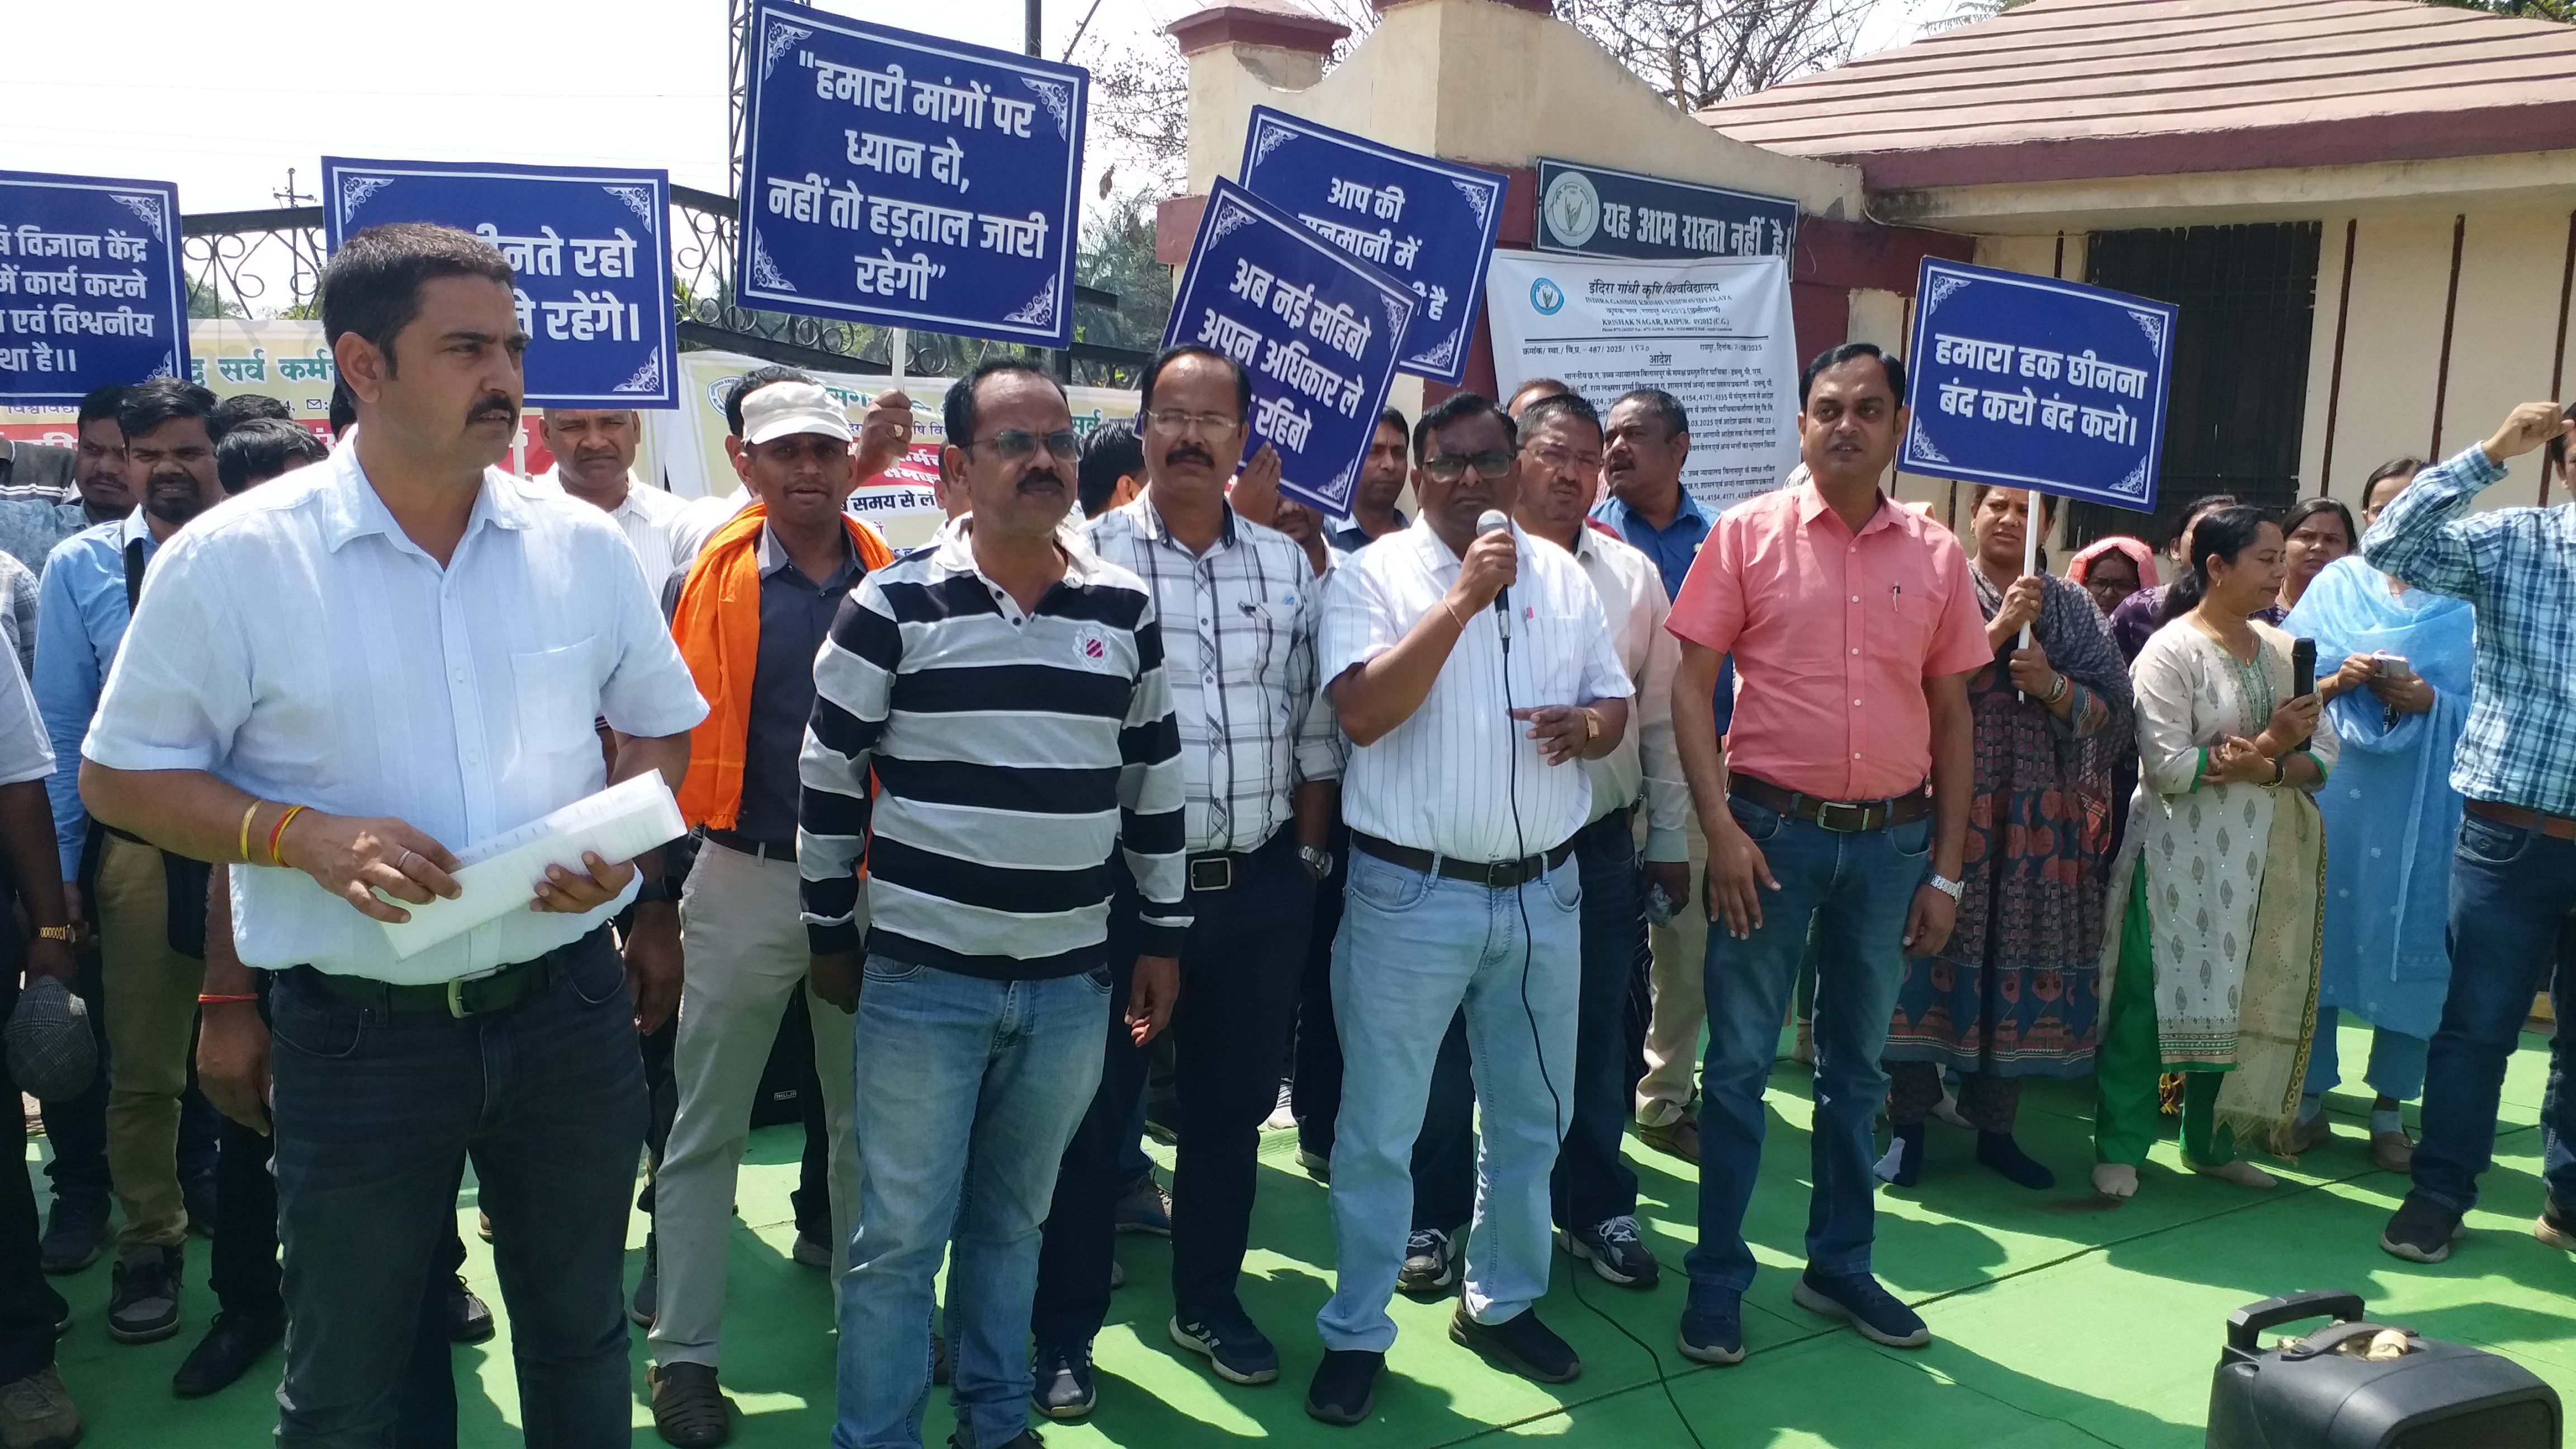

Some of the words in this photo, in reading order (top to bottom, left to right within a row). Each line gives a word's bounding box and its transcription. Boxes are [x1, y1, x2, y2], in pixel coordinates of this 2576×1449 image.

[911, 77, 991, 130] मांगों
[991, 96, 1036, 138] पर
[845, 129, 926, 179] ध्यान
[930, 136, 970, 194] दो,
[767, 173, 831, 224] नहीं
[829, 180, 864, 230] तो
[868, 196, 973, 247] हड़ताल
[977, 211, 1049, 259] जारी
[1327, 177, 1374, 214] आप
[1375, 185, 1406, 223] की
[15, 225, 101, 259] विज्ञान
[104, 228, 148, 263] केंद्र
[1602, 202, 1631, 239] यह
[1636, 206, 1678, 247] आम
[1681, 214, 1726, 254] रास्ता
[1730, 215, 1765, 256] नहीं
[569, 227, 637, 278] रहो
[1394, 237, 1423, 271] में
[21, 265, 78, 296] कार्य
[81, 268, 148, 299] करने
[1589, 279, 1615, 296] इंदिरा
[1617, 280, 1640, 295] गांधी
[1642, 281, 1663, 299] कृषि
[1663, 280, 1720, 295] विश्वविद्यालय
[1609, 297, 1637, 306] GANDHI
[1664, 295, 1732, 306] VISHWAVIDYALAYA
[9, 304, 47, 334] एवं
[541, 290, 640, 341] रहेंगे।
[1229, 257, 1275, 309] अब
[1272, 279, 1315, 330] नई
[1309, 303, 1372, 362] सहिबो
[1428, 284, 1448, 322] है
[1636, 318, 1663, 327] NAGAR,
[217, 348, 266, 381] सर्व
[1197, 307, 1263, 367] अपन
[1259, 339, 1343, 408] अधिकार
[1338, 373, 1365, 419] ले
[1564, 370, 1587, 380] माननीय
[1614, 370, 1640, 378] न्यायालय
[1649, 351, 1672, 364] आदेश
[1934, 333, 2015, 375] हमारा
[2018, 345, 2064, 381] हक
[2067, 349, 2148, 400] छीनना
[1601, 384, 1621, 392] लक्ष्मण
[1621, 381, 1635, 392] शर्मा
[1254, 397, 1313, 454] रहिबो
[1939, 377, 1978, 418] बंद
[1981, 386, 2038, 427] करो
[2040, 392, 2078, 434] बंद
[2080, 404, 2138, 447] करो।
[1702, 429, 1720, 438] आगामी
[851, 494, 896, 512] समय
[898, 490, 917, 508] से
